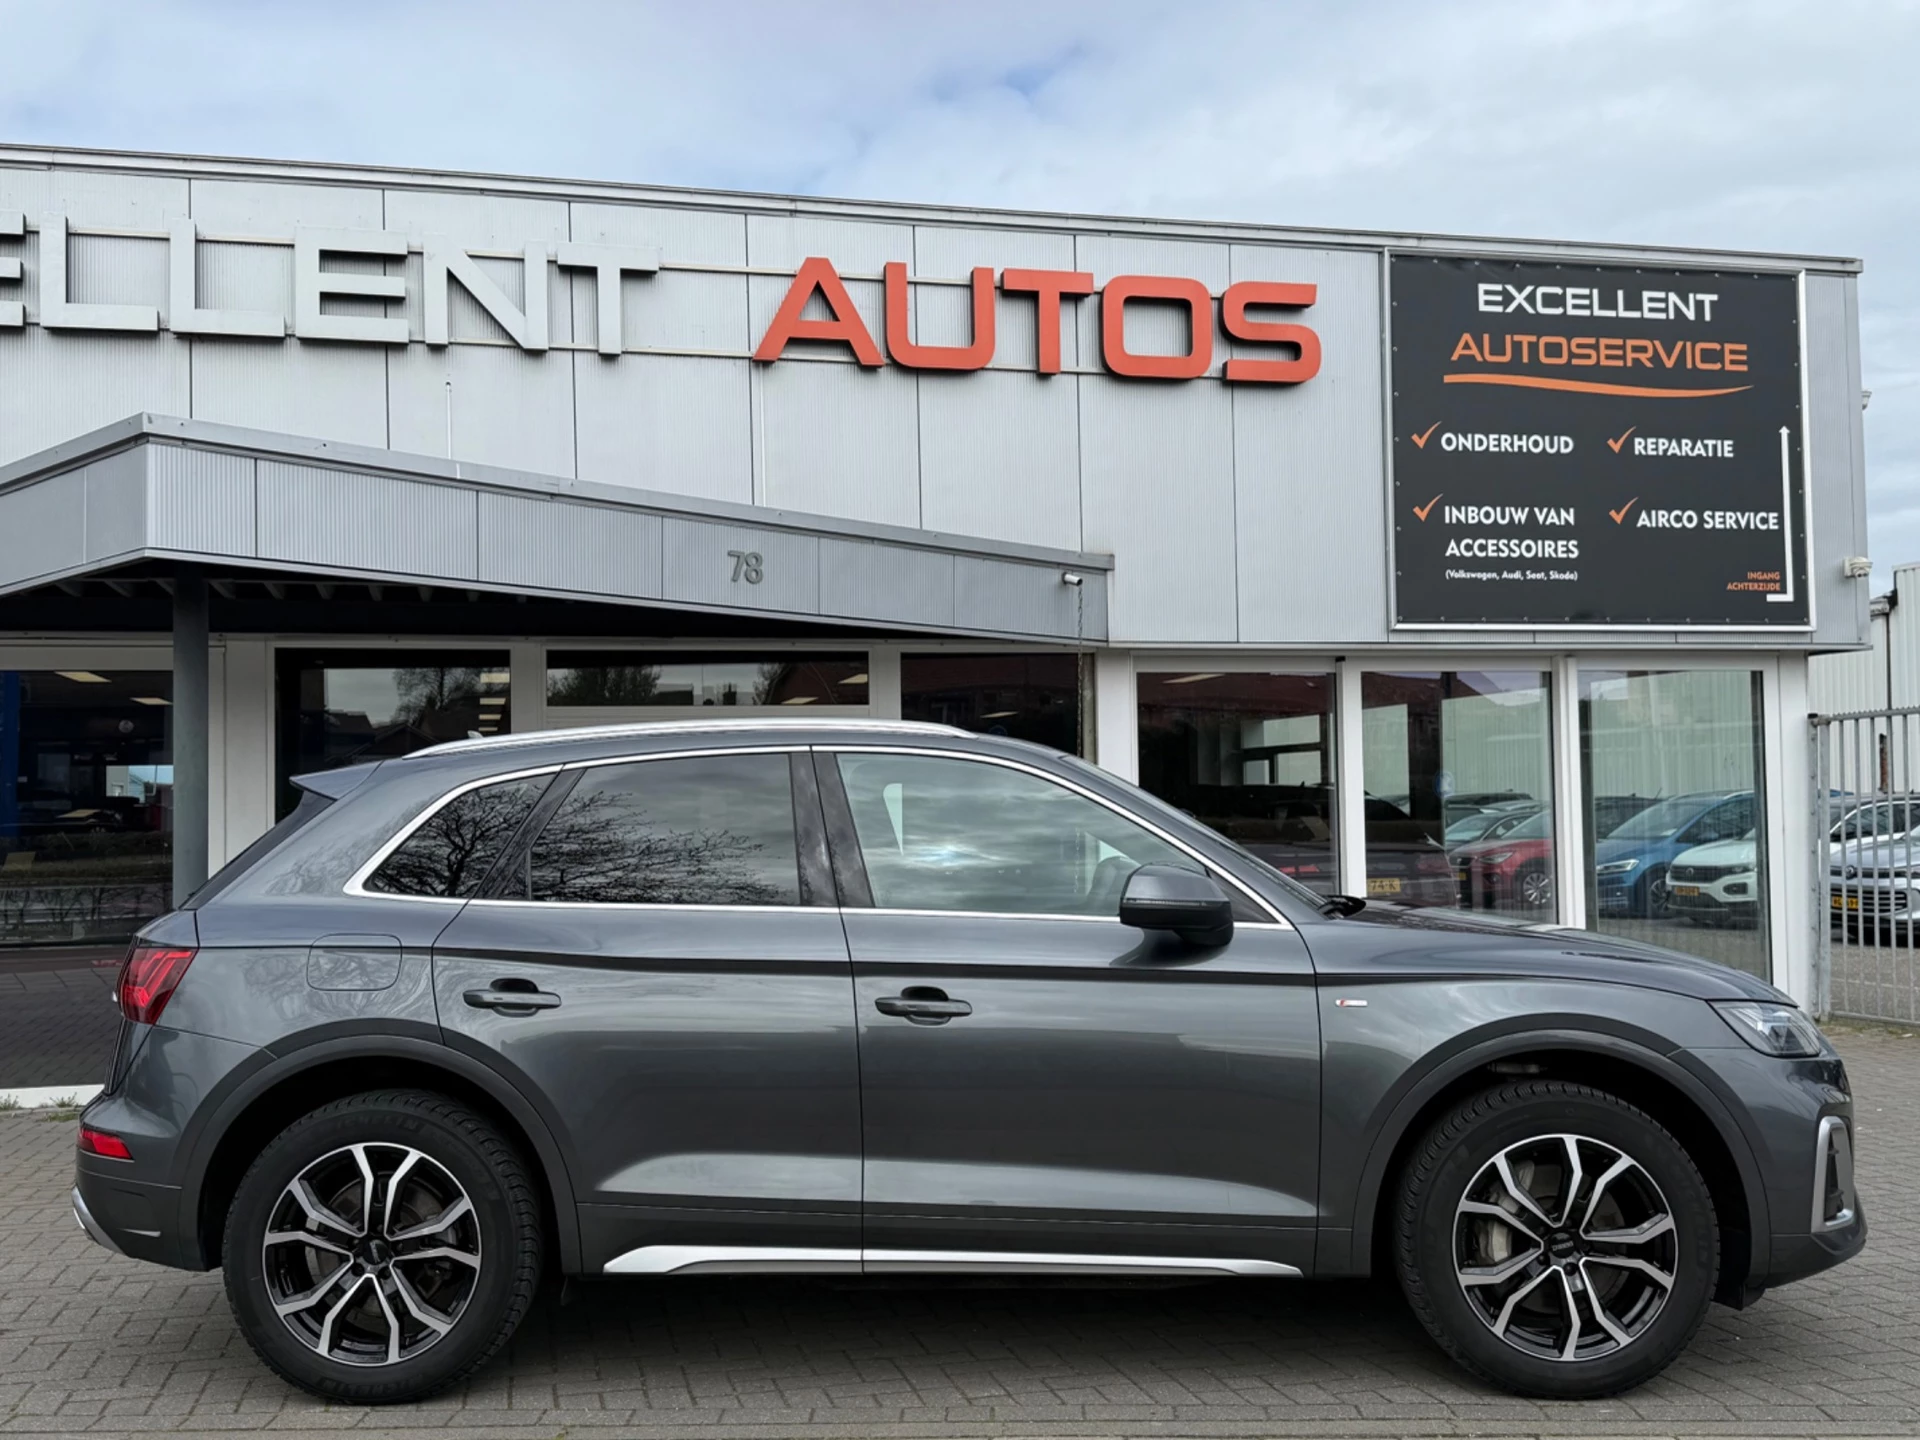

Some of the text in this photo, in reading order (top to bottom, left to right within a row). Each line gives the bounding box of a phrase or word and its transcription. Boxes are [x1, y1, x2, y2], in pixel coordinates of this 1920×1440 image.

[0, 210, 1322, 383] LLENT AUTOS
[1477, 282, 1719, 322] EXCELLENT
[1450, 332, 1748, 372] AUTOSERVICE
[1440, 432, 1574, 454] ONDERHOUD
[1633, 437, 1735, 458] REPARATIE
[1444, 505, 1576, 526] INBOUW VAN
[1636, 509, 1780, 531] AIRCO SERVICE
[1444, 538, 1580, 559] ACCESSOIRES
[727, 550, 764, 585] 78
[1445, 569, 1500, 581] (Volkswagen,
[1501, 570, 1524, 581] Audi,
[1525, 570, 1548, 581] Seat,
[1747, 571, 1781, 581] INGANG
[1726, 581, 1781, 592] ACHTERZIJDE
